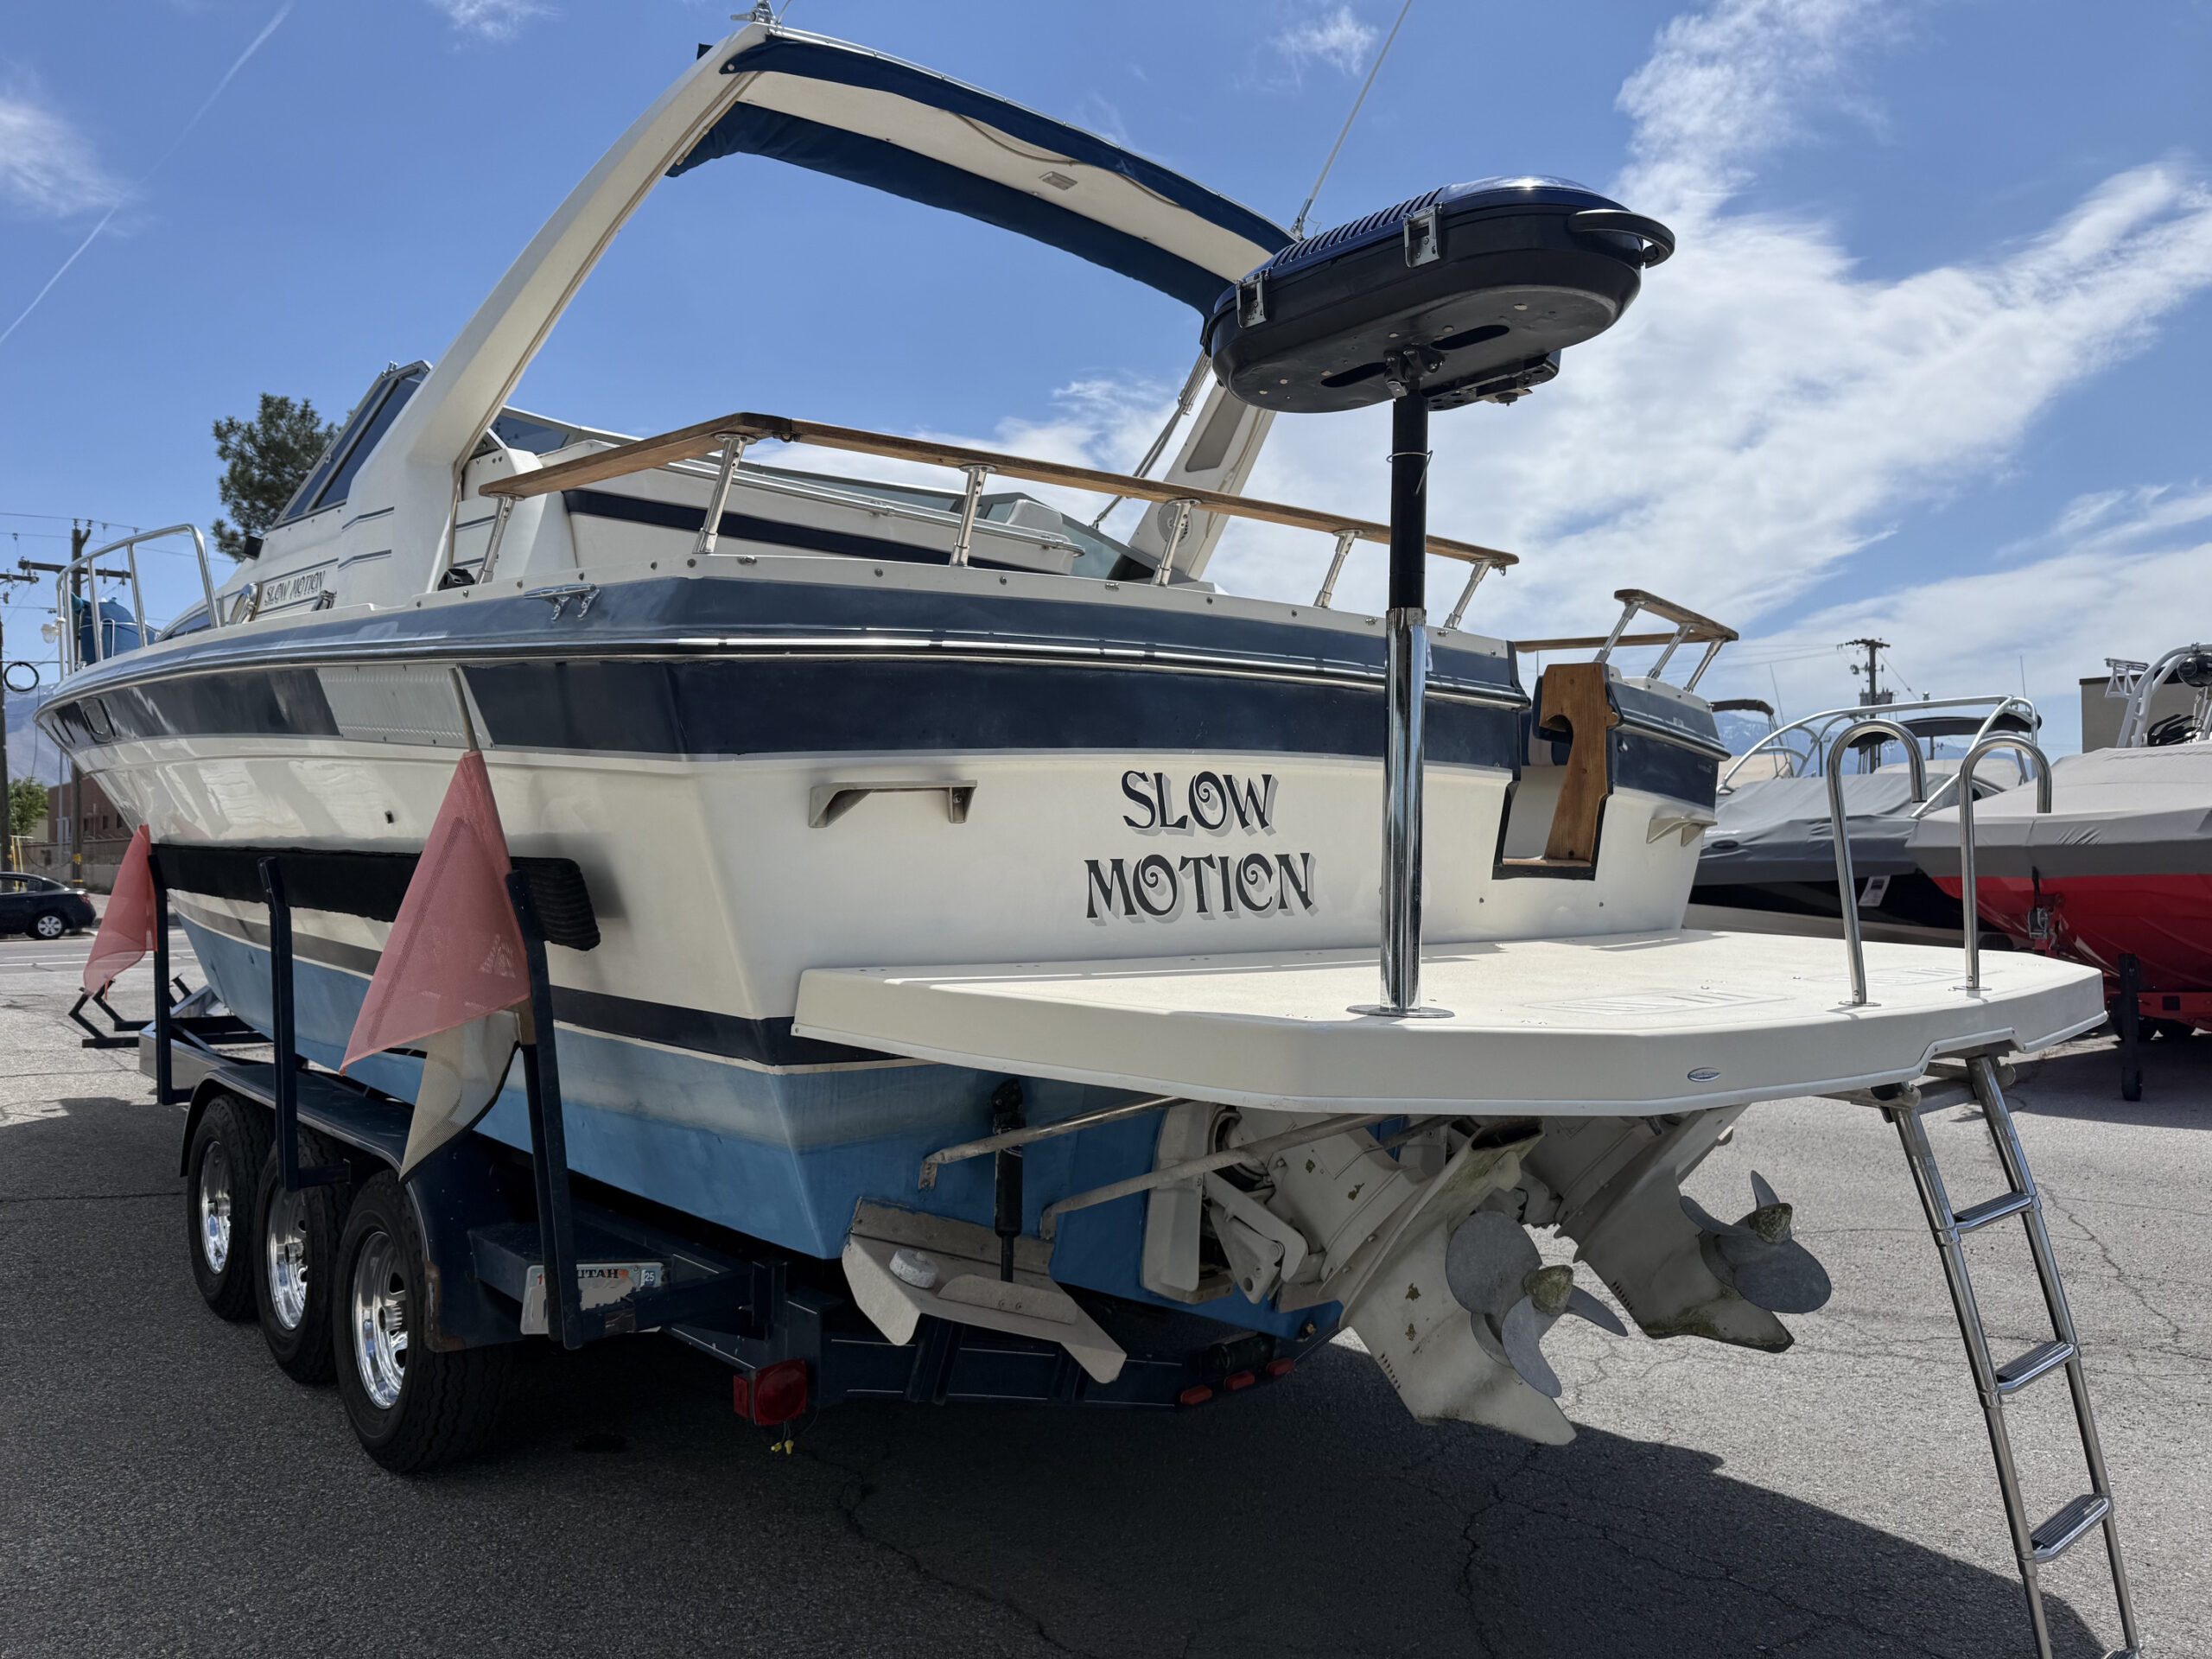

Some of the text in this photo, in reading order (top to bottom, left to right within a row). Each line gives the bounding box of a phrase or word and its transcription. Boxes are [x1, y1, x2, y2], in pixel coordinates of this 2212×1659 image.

[264, 570, 326, 605] SLOW MOTION
[1121, 770, 1278, 836] SLOW
[1084, 852, 1319, 925] MOTION
[645, 1272, 654, 1281] 25
